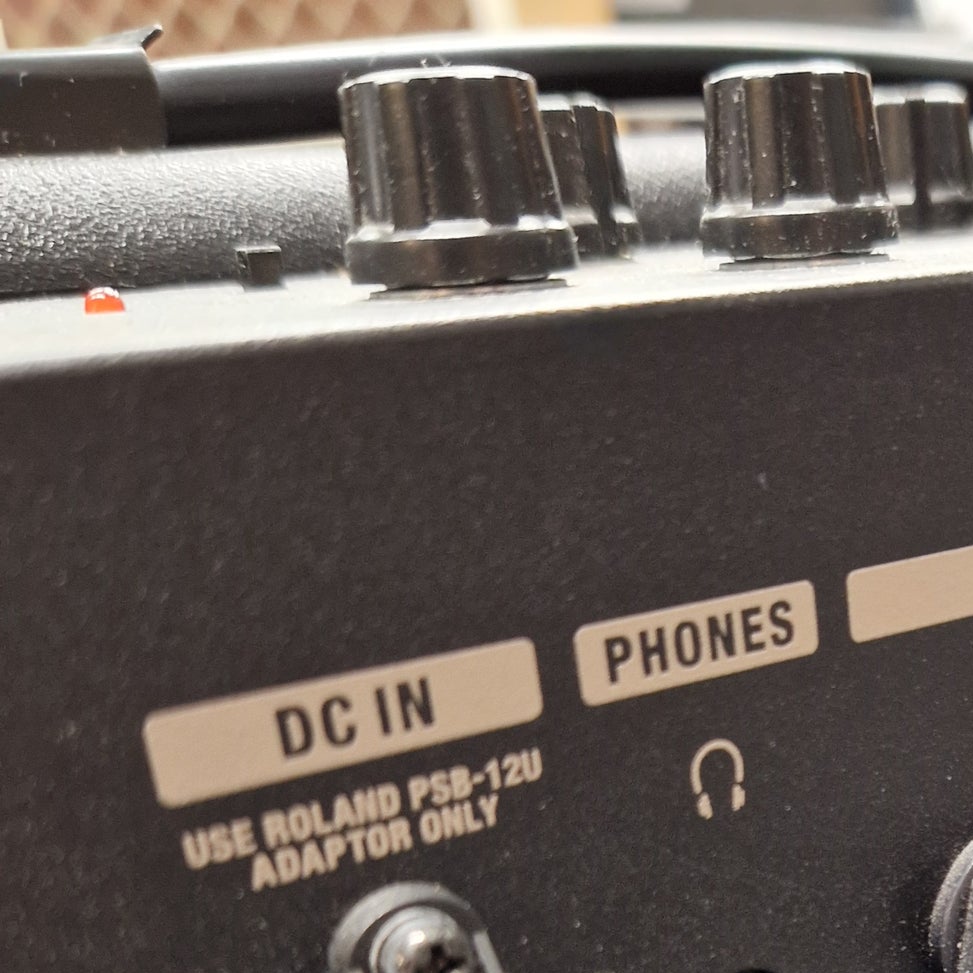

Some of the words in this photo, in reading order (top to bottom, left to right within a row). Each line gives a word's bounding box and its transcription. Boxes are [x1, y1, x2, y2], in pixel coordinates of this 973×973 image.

[603, 600, 796, 684] PHONES
[274, 695, 359, 760] DC
[376, 676, 437, 735] IN
[181, 817, 258, 870] USE
[261, 782, 402, 849] ROLAND
[407, 748, 545, 811] PSB-12U
[250, 815, 414, 893] ADAPTOR
[419, 792, 500, 845] ONLY
